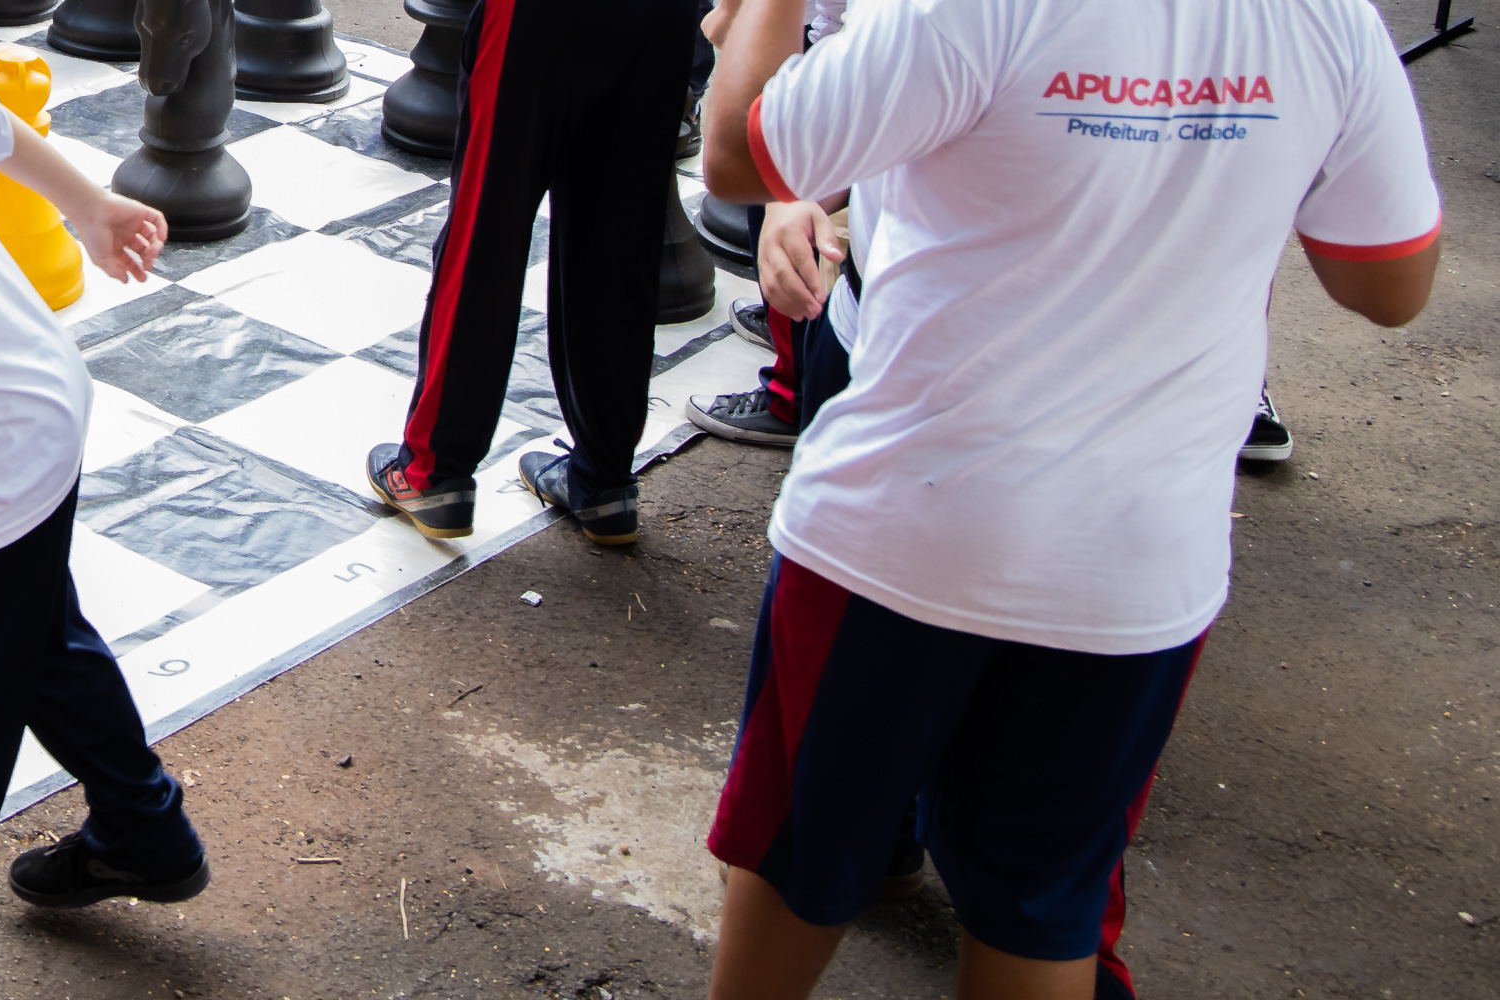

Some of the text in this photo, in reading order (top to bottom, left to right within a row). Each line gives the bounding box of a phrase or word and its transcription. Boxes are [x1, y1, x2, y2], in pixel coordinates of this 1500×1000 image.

[1042, 71, 1276, 108] APUCARANA
[1067, 118, 1247, 142] Prefeitura Cidade
[333, 562, 377, 583] 5
